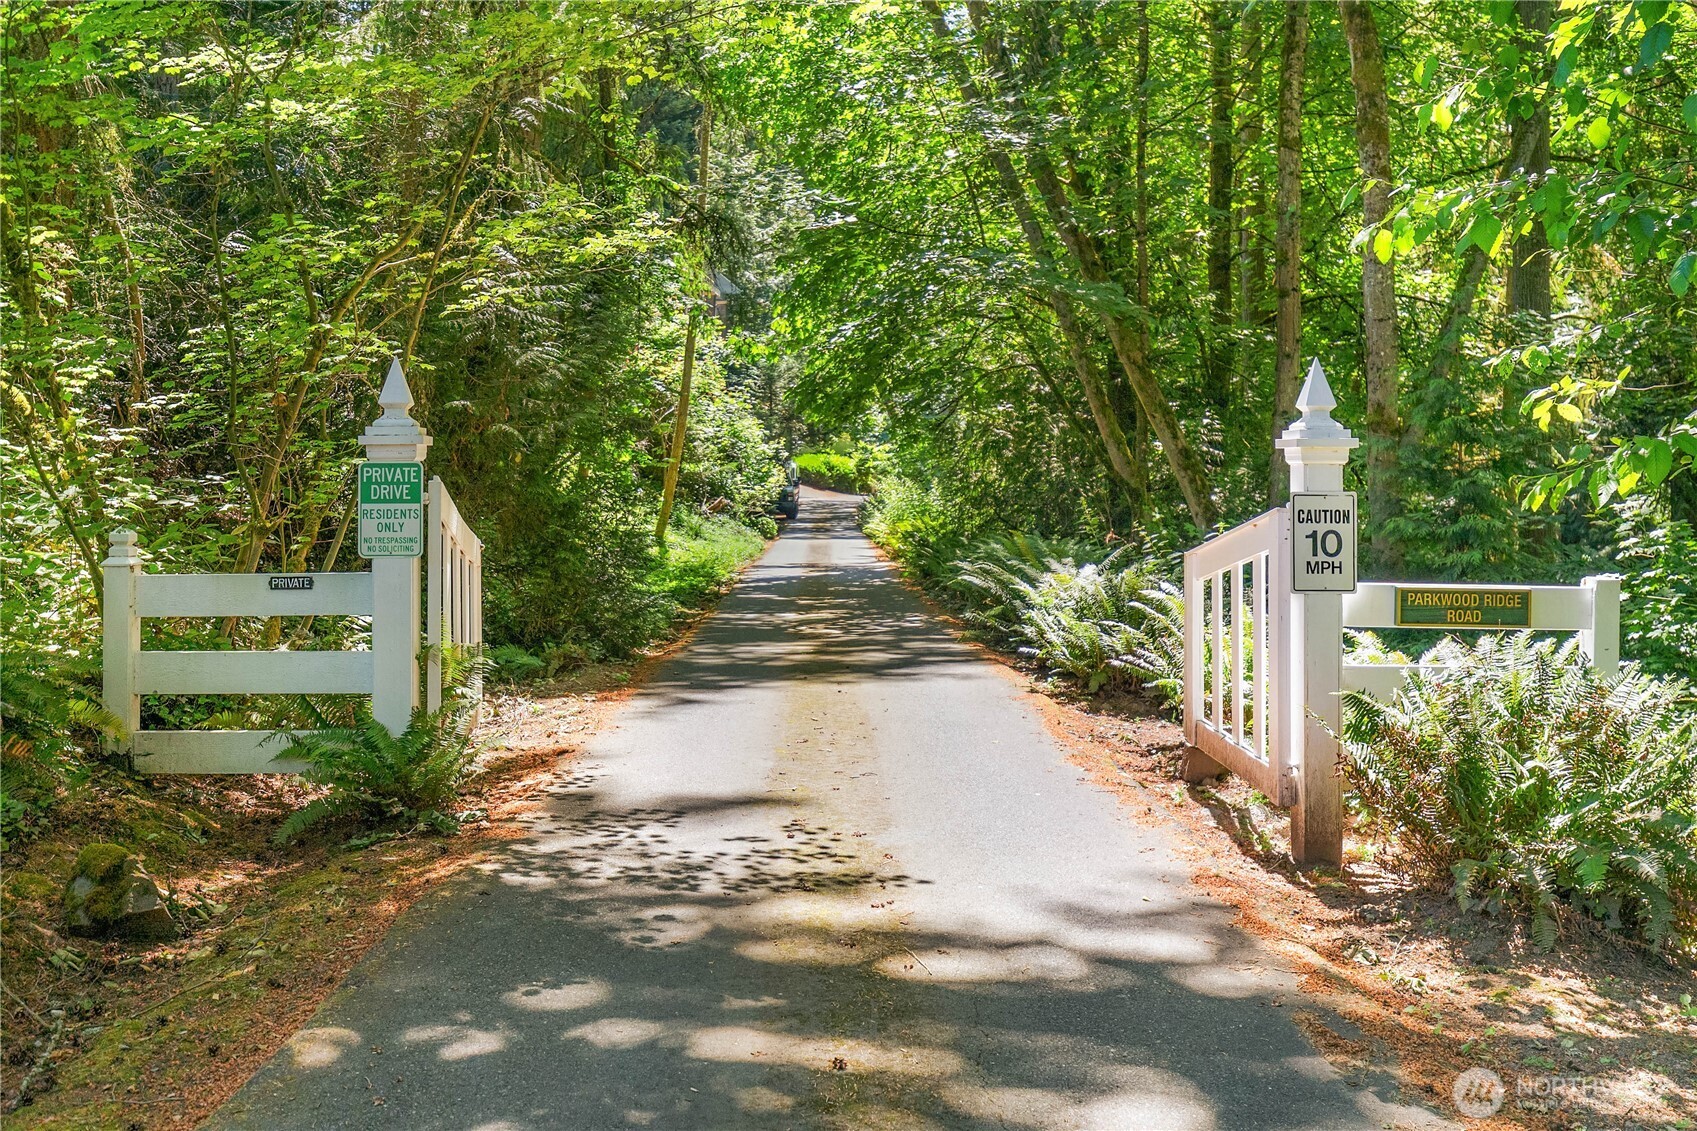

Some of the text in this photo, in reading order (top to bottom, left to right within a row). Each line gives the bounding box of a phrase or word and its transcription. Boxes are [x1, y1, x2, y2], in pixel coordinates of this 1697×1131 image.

[363, 467, 419, 482] PRIVATE
[370, 484, 411, 500] DRIVE
[362, 508, 419, 520] RESIDENTS
[1297, 509, 1351, 524] CAUTION
[376, 522, 405, 533] ONLY
[363, 536, 418, 545] NO TRESPASSING
[1305, 529, 1343, 558] 10
[367, 545, 415, 553] NO SOLICITING
[1306, 560, 1343, 575] MPH
[271, 577, 310, 589] PRIVATE
[1407, 592, 1522, 608] PARKWOOD RIDGE
[1447, 609, 1482, 623] ROAD
